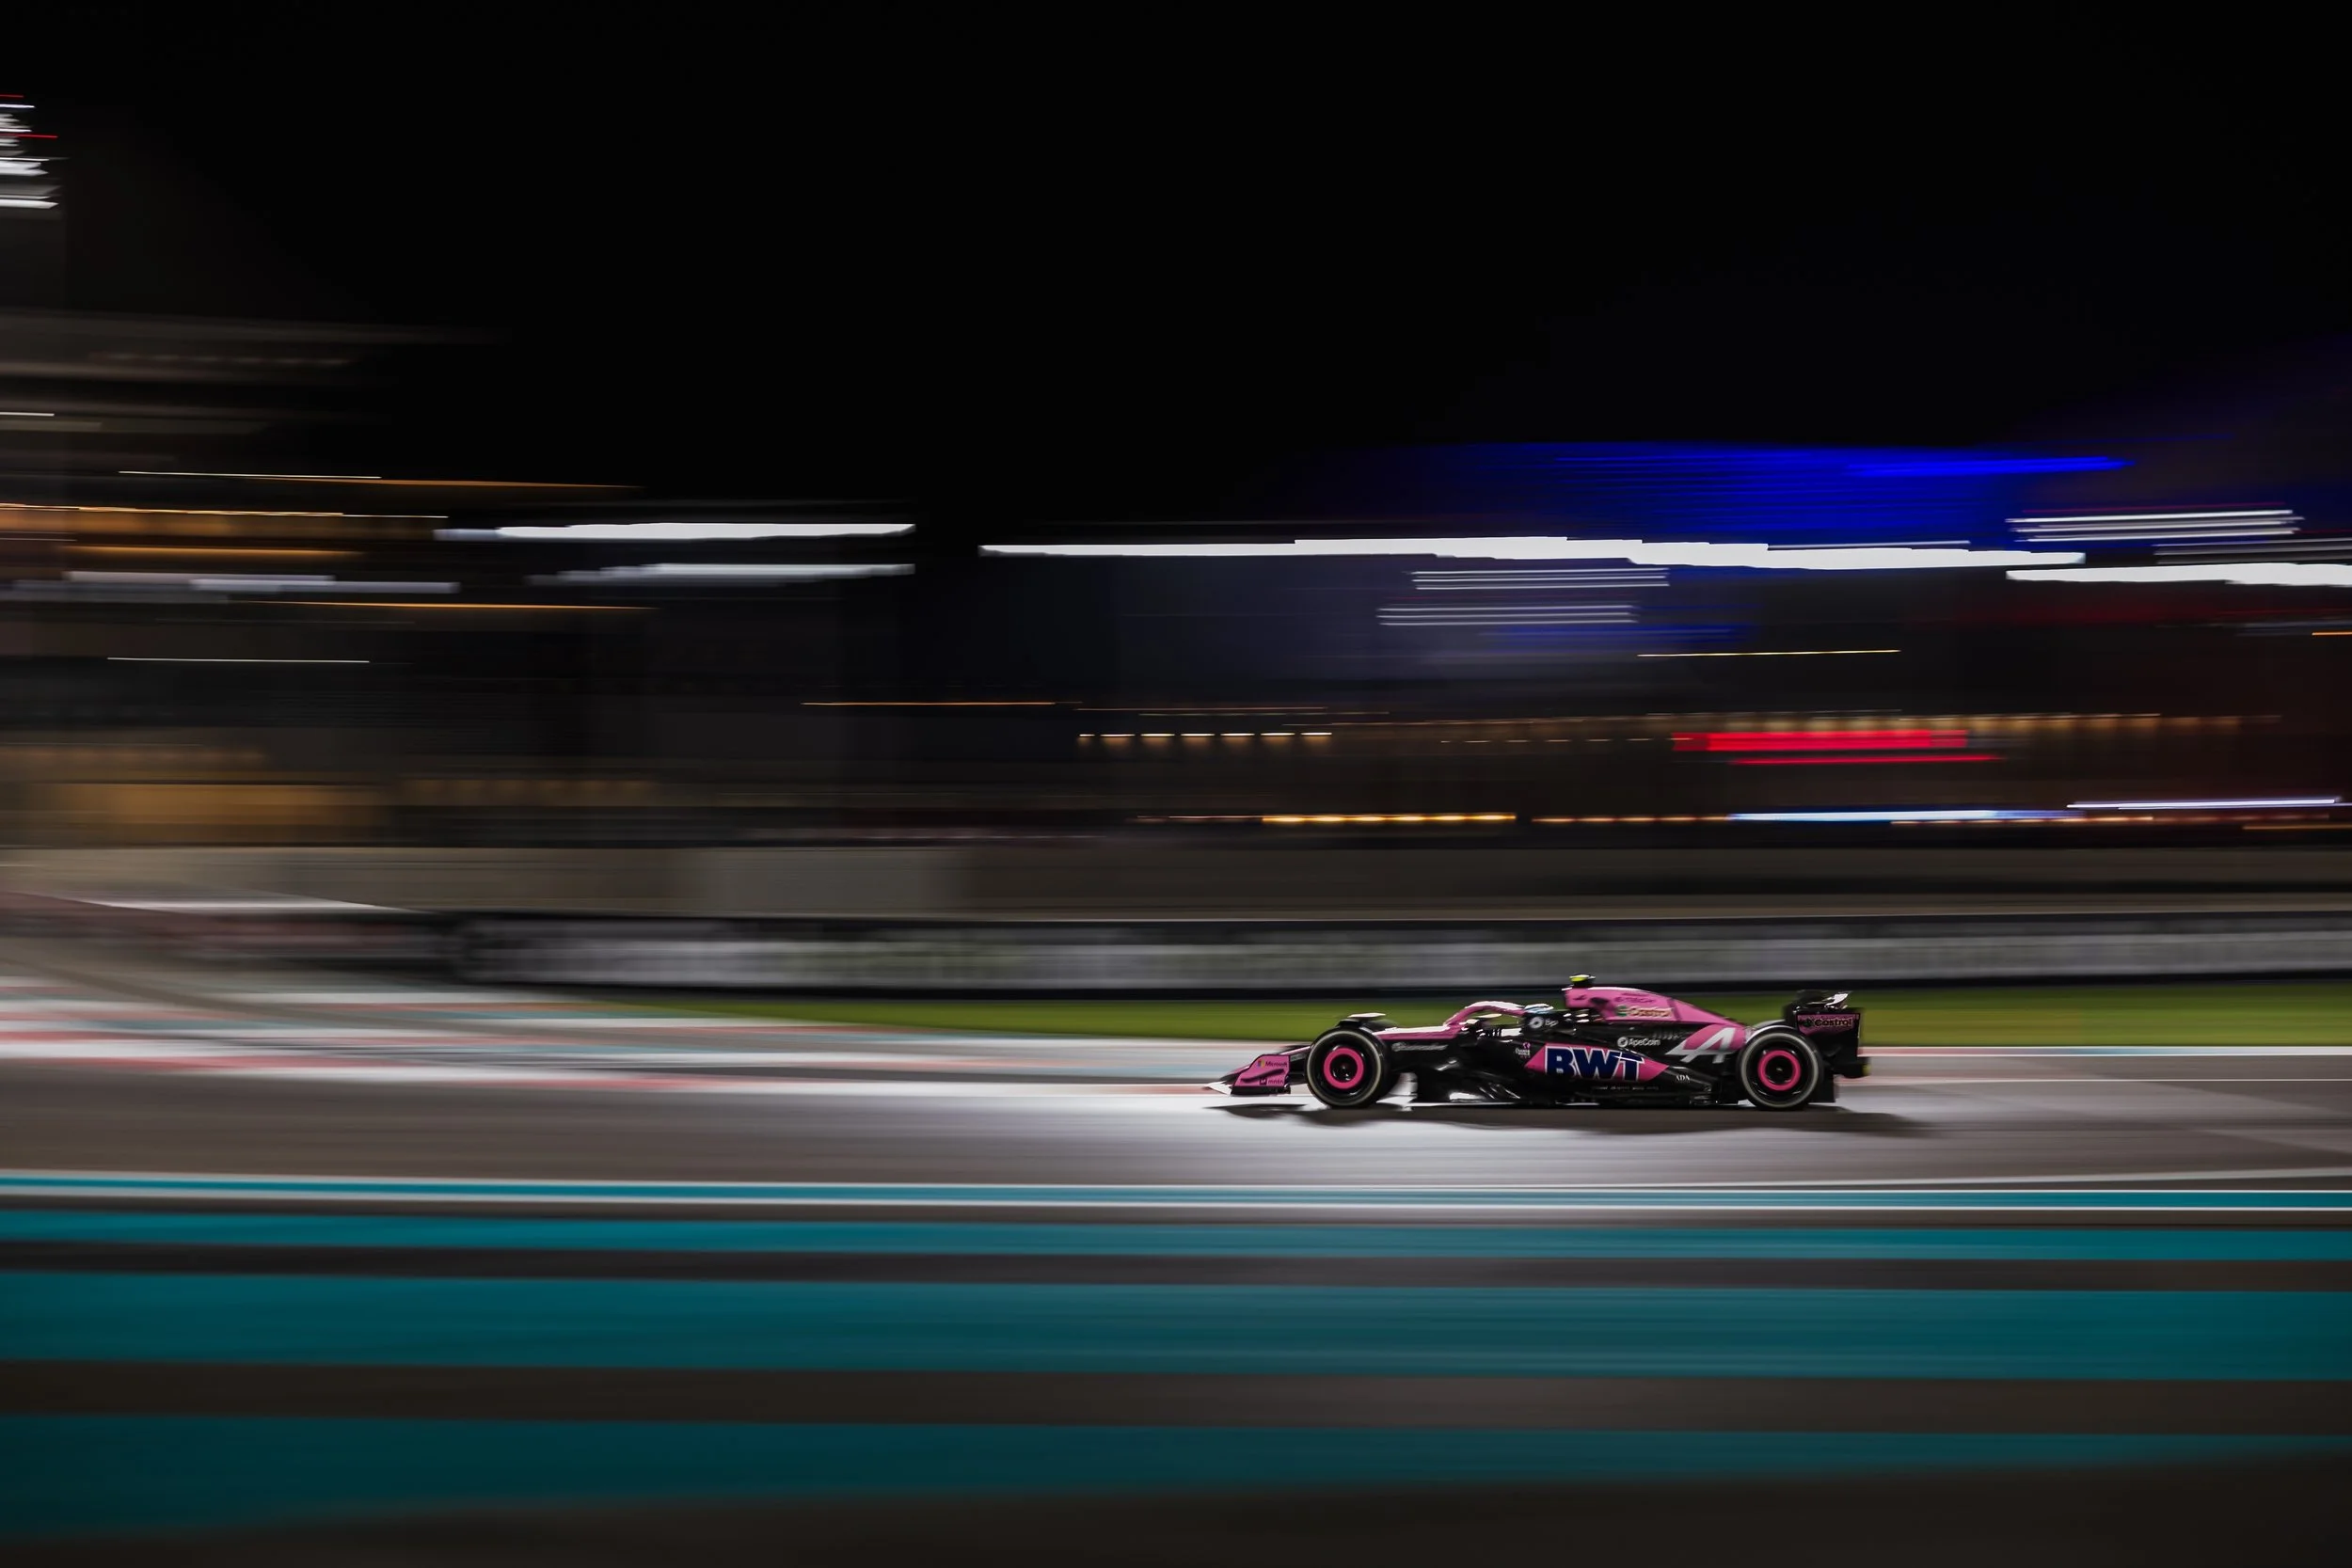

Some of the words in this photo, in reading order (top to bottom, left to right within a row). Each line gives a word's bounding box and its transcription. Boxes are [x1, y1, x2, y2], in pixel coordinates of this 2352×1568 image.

[1814, 1017, 1852, 1027] Castrol
[1628, 1037, 1661, 1047] ApeCoin
[1545, 1045, 1645, 1081] BWT
